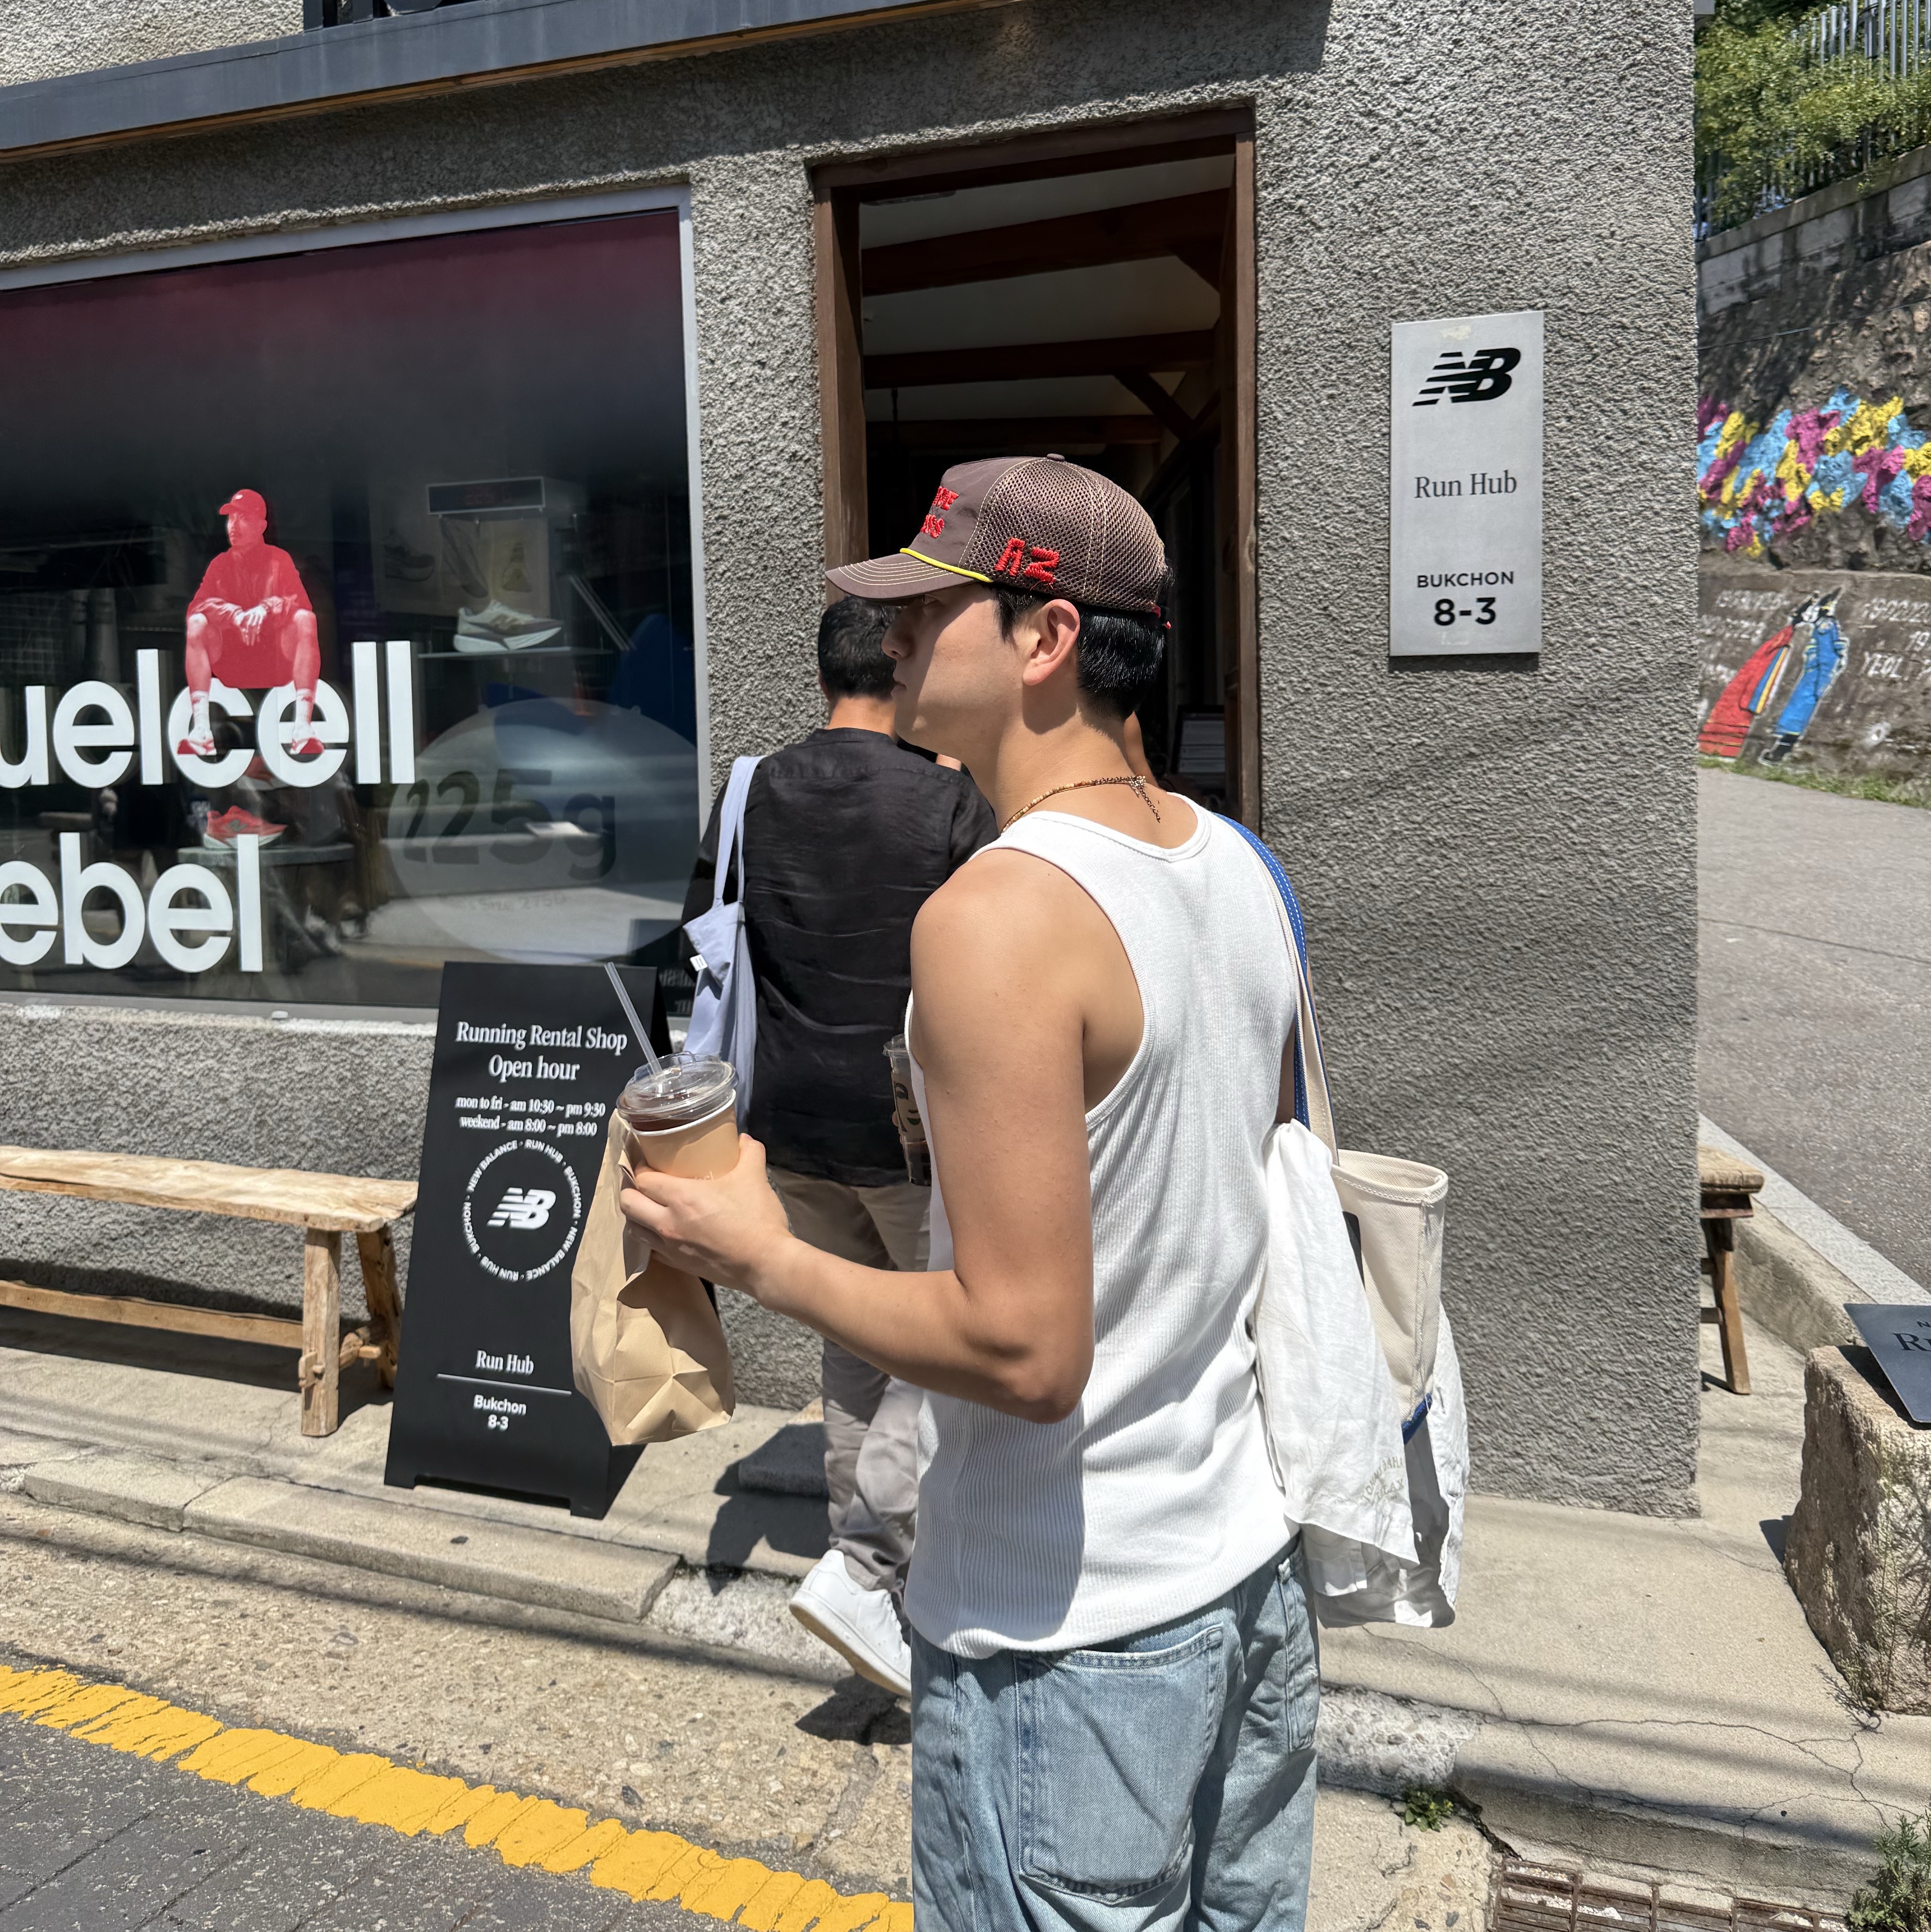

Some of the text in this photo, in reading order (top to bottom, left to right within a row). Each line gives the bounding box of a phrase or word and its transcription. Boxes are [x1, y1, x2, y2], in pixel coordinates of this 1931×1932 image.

[1414, 470, 1517, 499] Run Hub
[1417, 571, 1514, 588] BUKCHON
[1433, 597, 1497, 626] 8-3
[456, 1021, 628, 1055] Running Rental Shop
[488, 1054, 580, 1082] Open hour
[454, 1097, 478, 1108] mon
[479, 1097, 490, 1109] to
[490, 1095, 503, 1110] fri
[509, 1100, 526, 1112] am
[527, 1099, 555, 1115] 10:30
[565, 1103, 583, 1118] pm
[583, 1102, 606, 1118] 9:30
[459, 1114, 500, 1129] weekend
[506, 1120, 524, 1131] am
[524, 1118, 546, 1133] 8:00
[556, 1123, 574, 1138] pm
[574, 1121, 597, 1137] 8:00
[524, 1139, 564, 1164] RUN HUB
[466, 1140, 518, 1193] NEW BALANCE
[564, 1166, 582, 1219] BUKCHON
[462, 1202, 480, 1255] BUKCHON
[524, 1226, 578, 1281] NEW BALANCE
[479, 1256, 519, 1282] RUN HUB
[475, 1350, 534, 1375] Run Hub
[473, 1394, 527, 1415] Bukchon
[487, 1414, 509, 1430] 8-3
